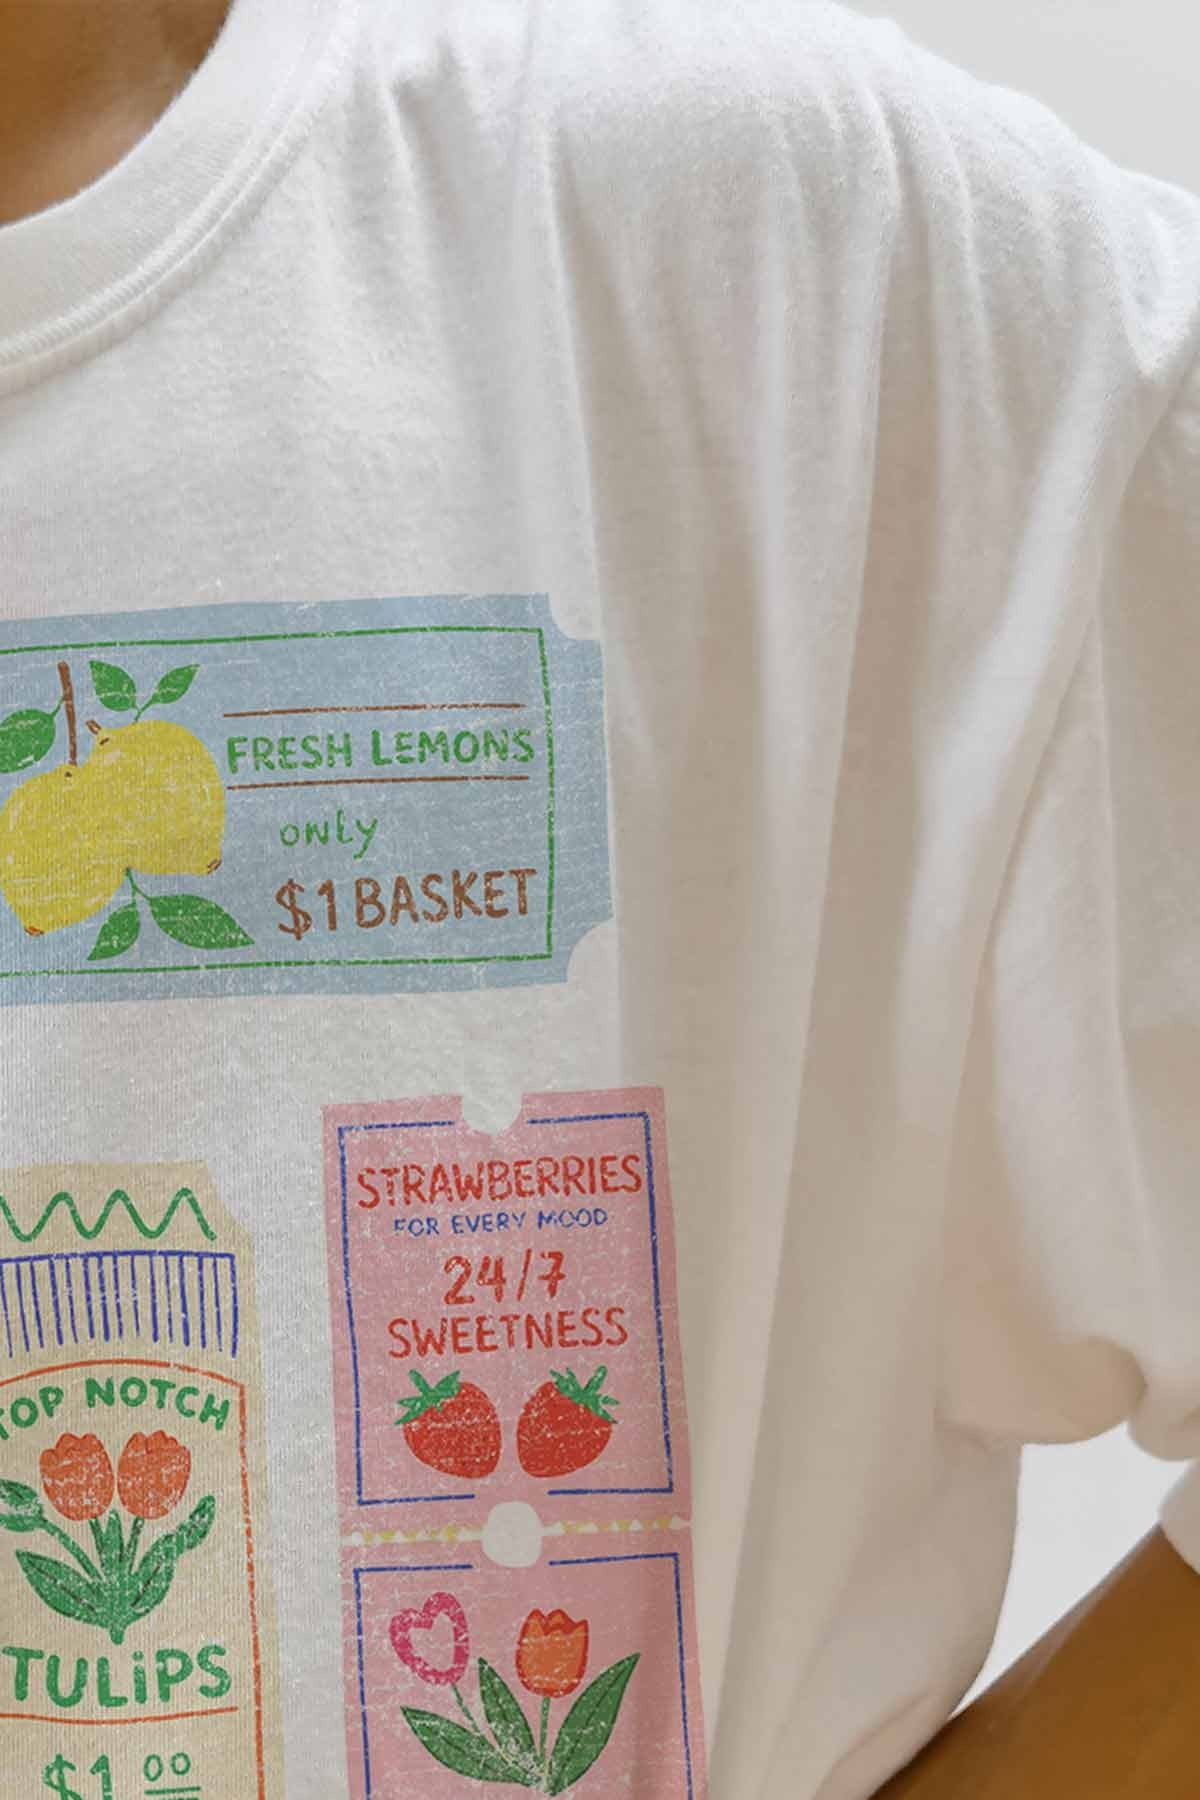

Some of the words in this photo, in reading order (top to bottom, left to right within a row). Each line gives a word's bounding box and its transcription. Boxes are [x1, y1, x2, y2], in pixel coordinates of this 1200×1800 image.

[227, 732, 353, 774] FRESH
[371, 727, 535, 766] LEMONS
[279, 809, 378, 859] only
[275, 878, 338, 940] $1
[355, 868, 537, 930] BASKET
[356, 1154, 643, 1209] STRAWBERRIES
[394, 1217, 440, 1238] FOR
[452, 1211, 527, 1235] EVERY
[538, 1207, 609, 1229] MOOD
[443, 1248, 567, 1305] 24/7
[387, 1307, 629, 1359] SWEETNESS
[85, 1376, 231, 1433] NOTCH
